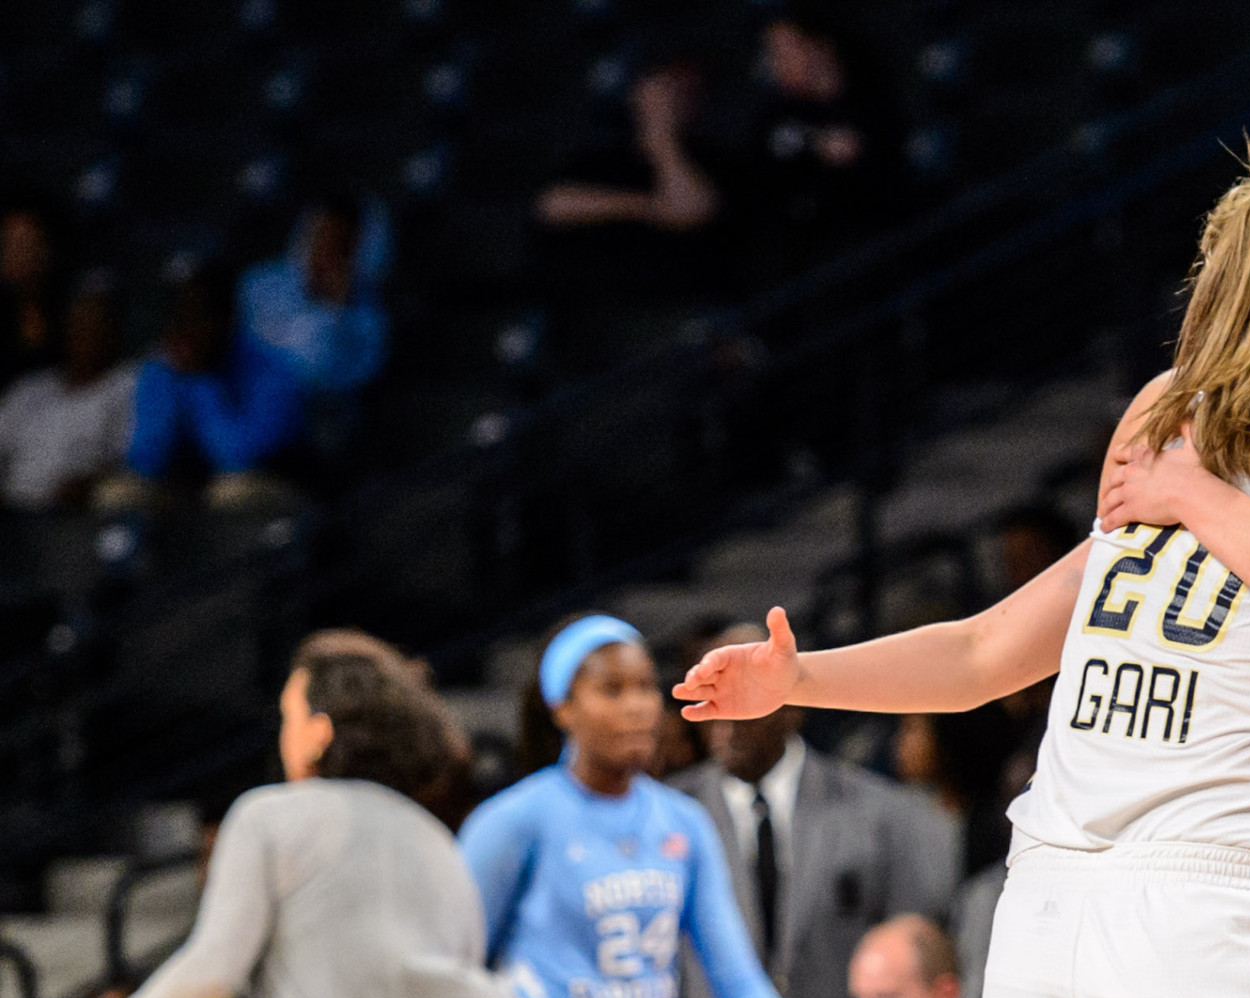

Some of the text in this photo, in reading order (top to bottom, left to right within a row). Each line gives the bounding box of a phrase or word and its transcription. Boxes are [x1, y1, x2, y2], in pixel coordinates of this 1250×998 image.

[1083, 522, 1248, 653] 20
[1069, 657, 1199, 744] GARI
[599, 911, 679, 976] 24
